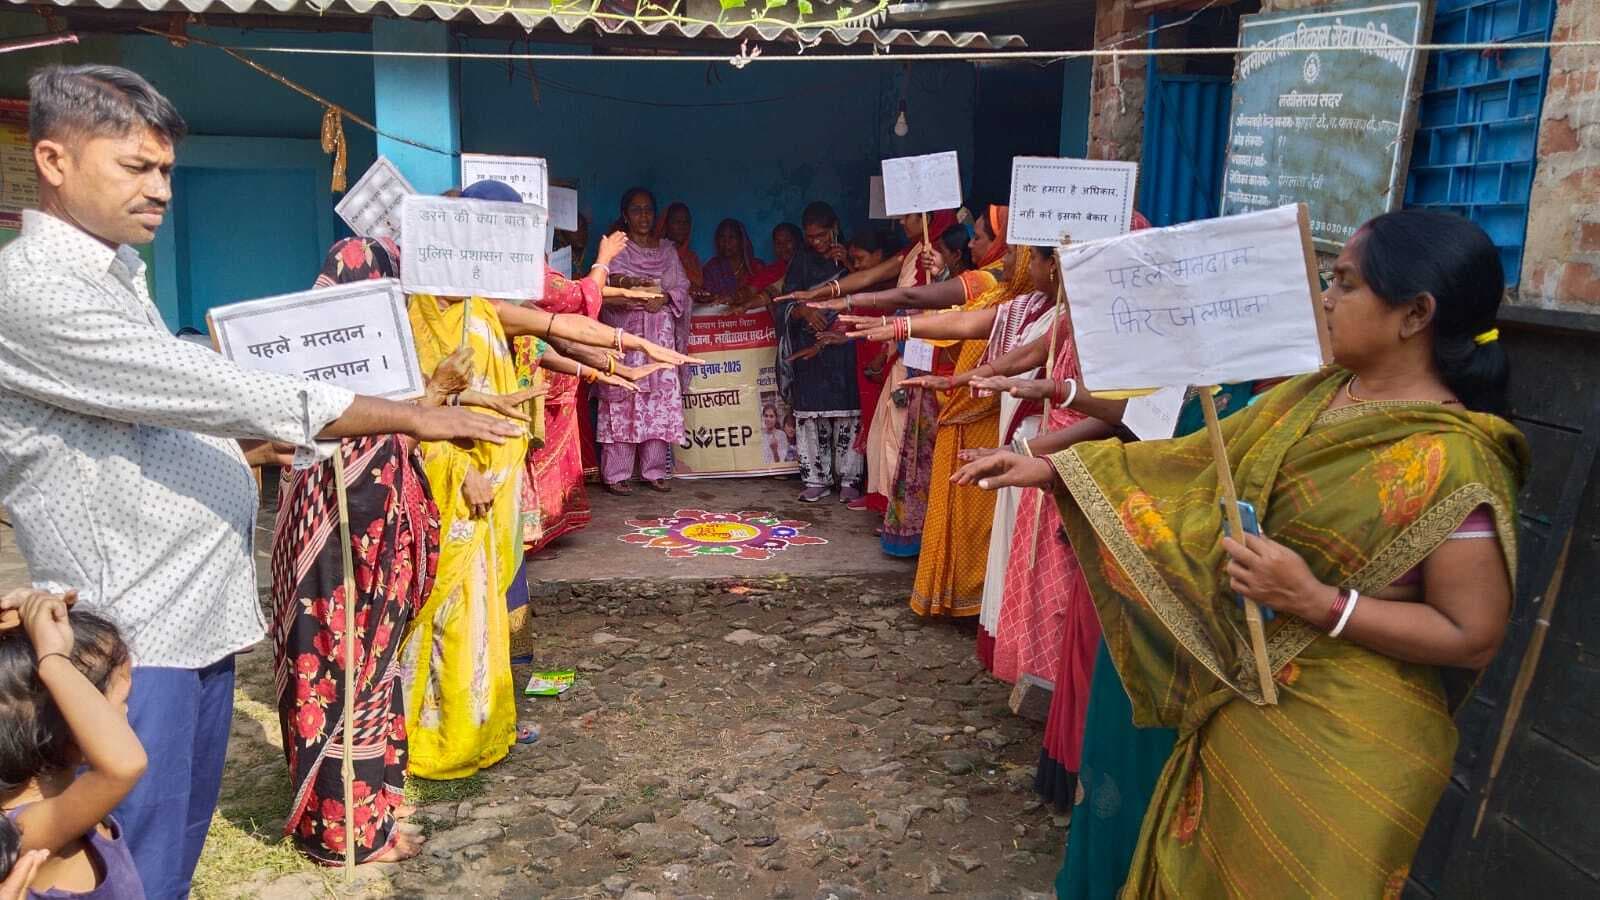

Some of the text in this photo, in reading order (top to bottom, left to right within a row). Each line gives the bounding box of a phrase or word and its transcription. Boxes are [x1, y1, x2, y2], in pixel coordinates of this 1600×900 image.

[1279, 90, 1343, 107] लखीसराय सदर
[1022, 183, 1038, 193] वोट
[1042, 184, 1066, 195] हमारा
[1070, 184, 1078, 195] है
[420, 207, 541, 228] डरने की क्या बात है
[1057, 211, 1081, 222] इसको
[1086, 212, 1109, 222] बेकार
[418, 243, 534, 265] पुलिस प्रशासन साथ
[472, 264, 481, 280] है
[1104, 246, 1255, 289] पहले मतदान
[1106, 294, 1270, 337] फिर जलपान
[248, 335, 291, 359] पहले
[301, 324, 366, 348] मतदान
[700, 360, 742, 379] चुनाव-2025
[680, 426, 753, 450] SWEEP
